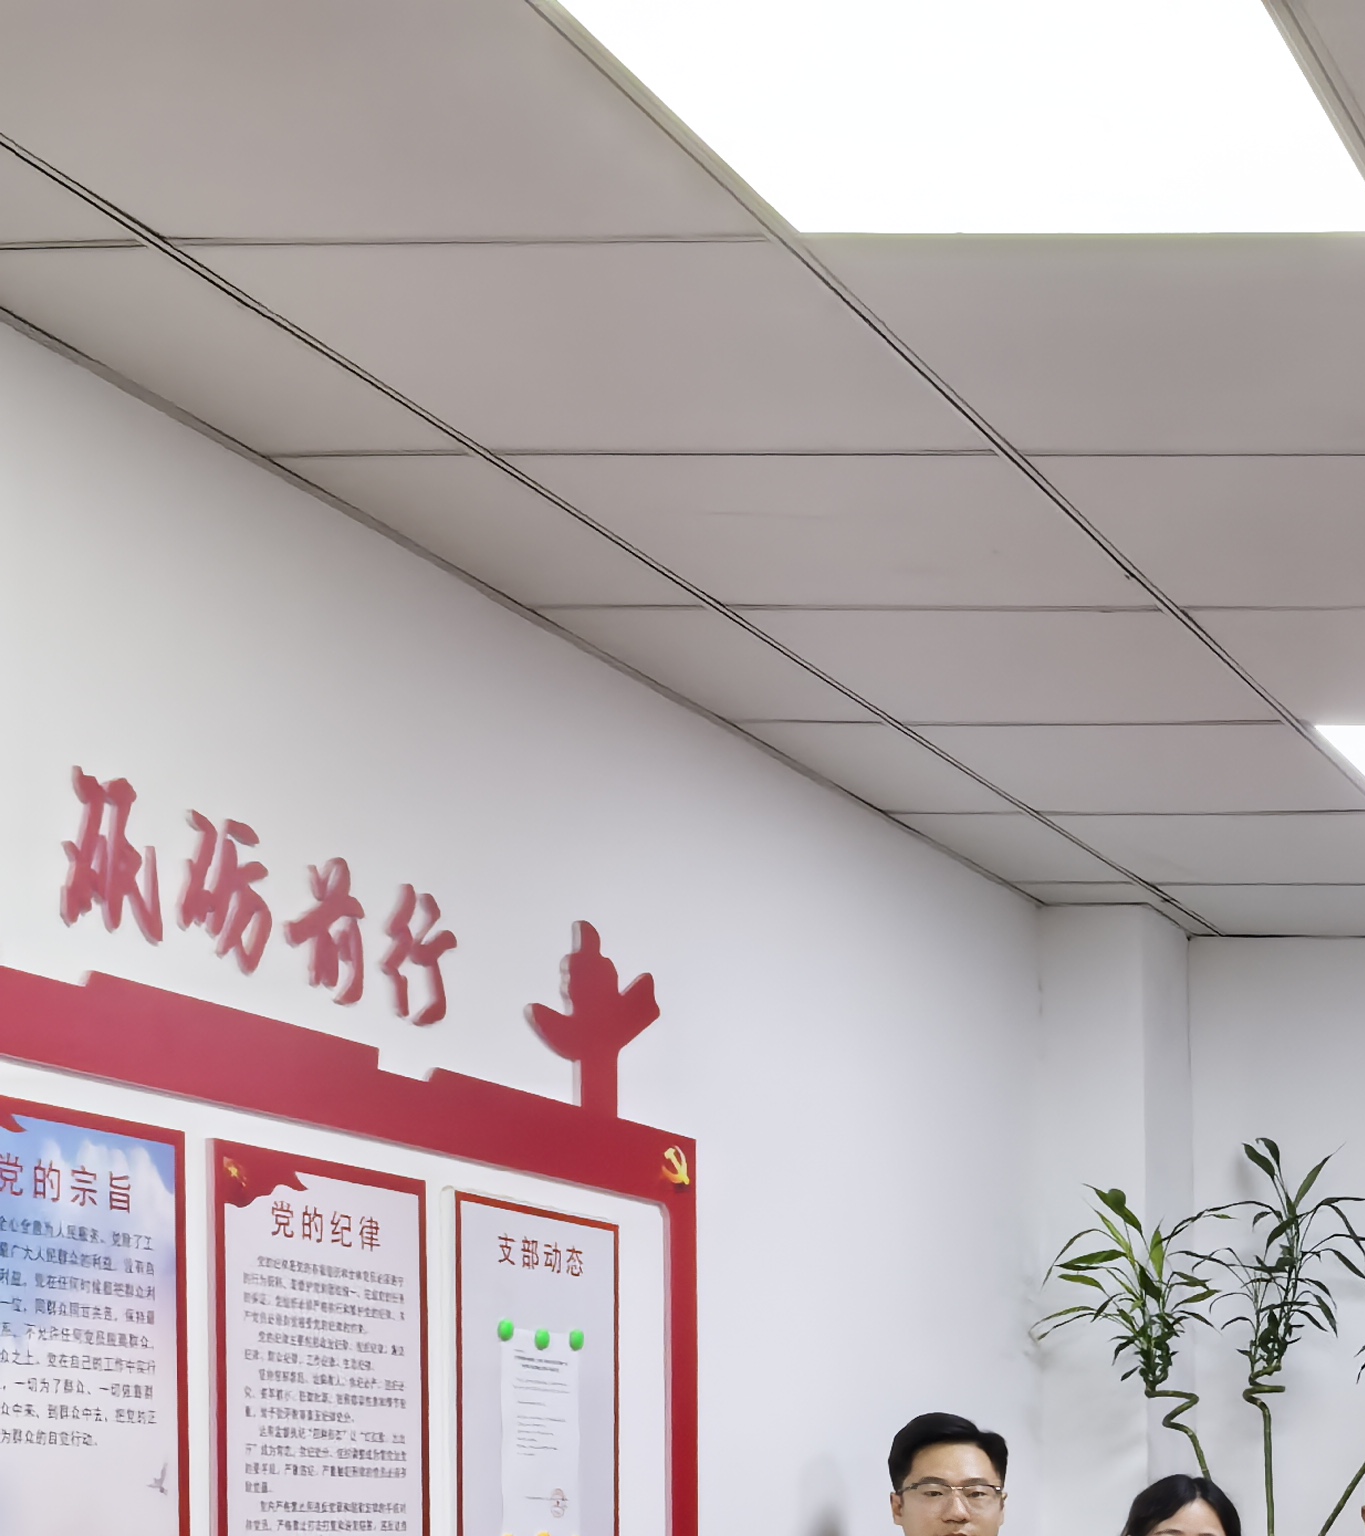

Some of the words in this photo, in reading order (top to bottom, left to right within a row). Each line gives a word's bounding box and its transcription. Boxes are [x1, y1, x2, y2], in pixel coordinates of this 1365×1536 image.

[0, 1152, 131, 1214] 党的宗旨
[271, 1200, 381, 1252] 党的纪律
[498, 1233, 584, 1277] 支部动态
